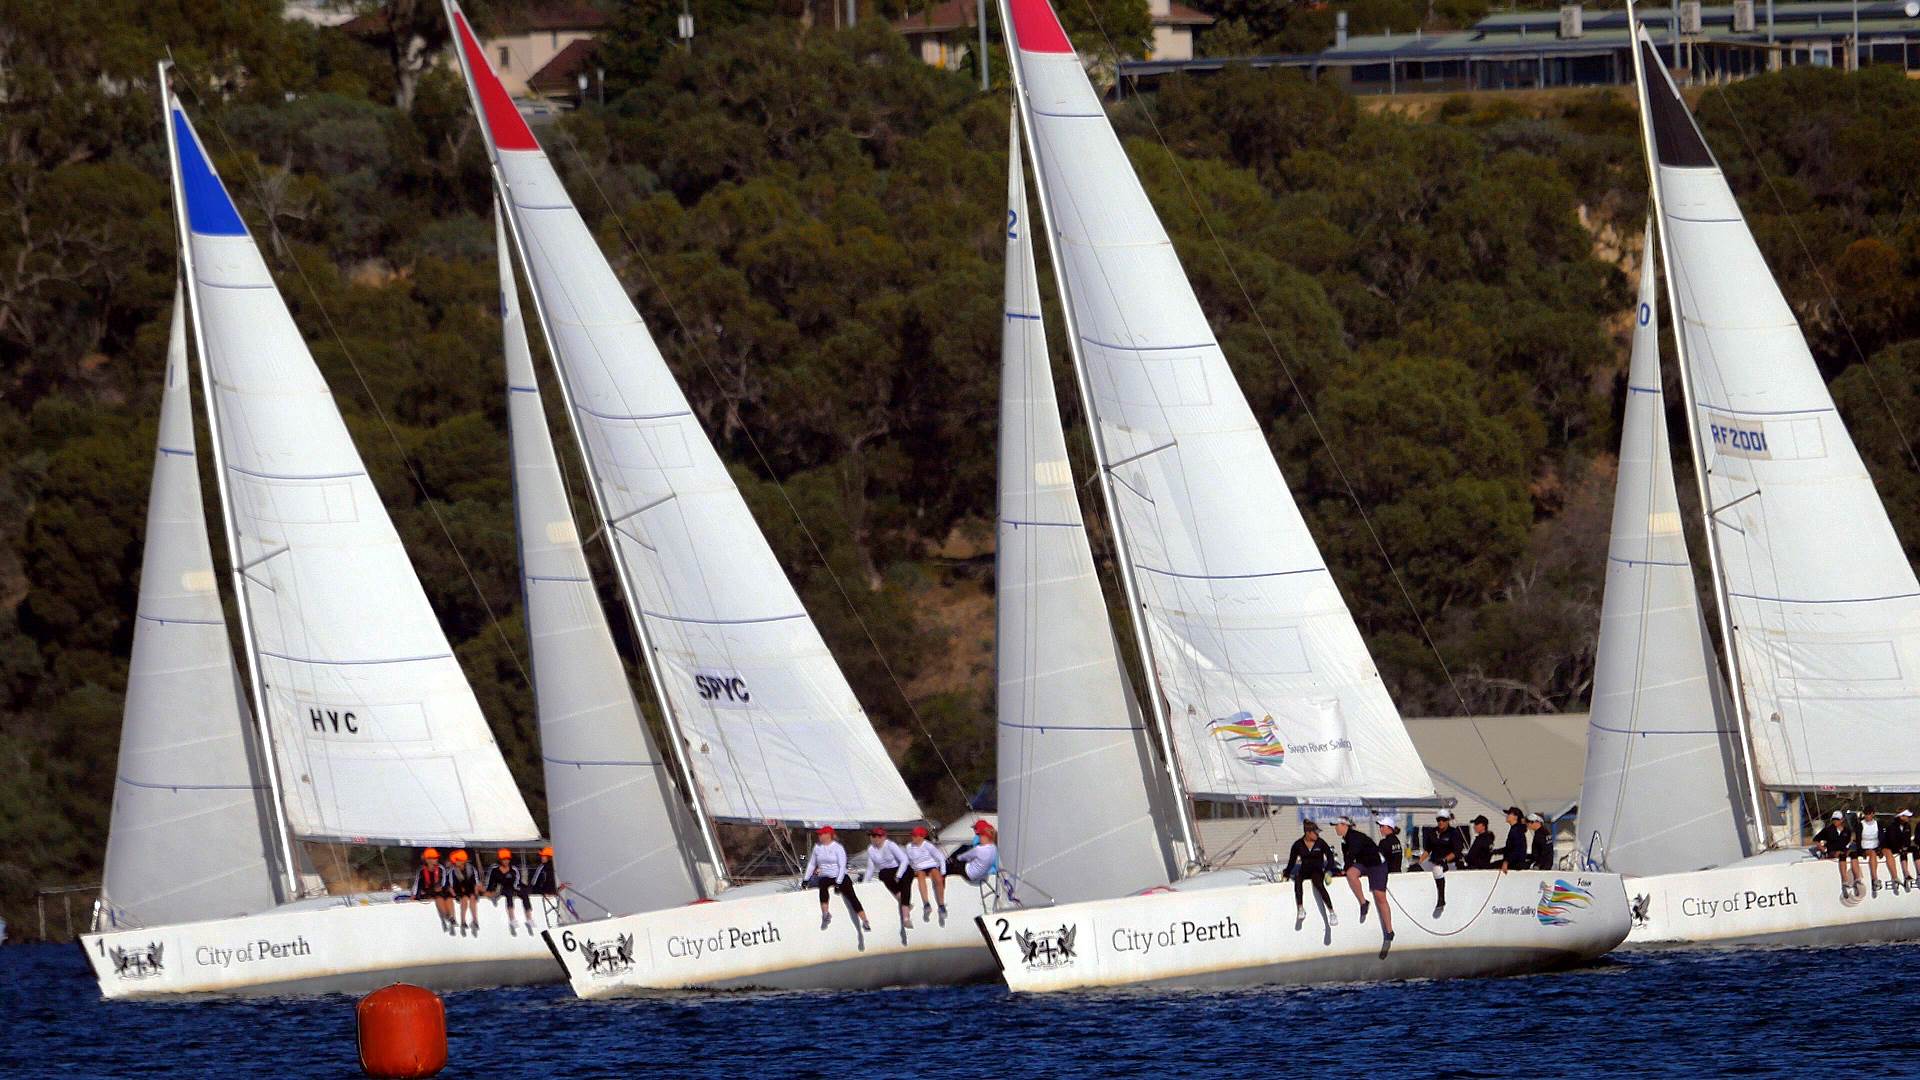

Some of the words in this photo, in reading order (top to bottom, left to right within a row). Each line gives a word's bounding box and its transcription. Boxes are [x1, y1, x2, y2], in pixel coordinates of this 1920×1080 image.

[1007, 209, 1018, 240] 2
[695, 675, 750, 703] SPYC
[309, 707, 359, 735] HYC
[1287, 743, 1309, 754] Swan
[1309, 742, 1328, 753] River
[1329, 737, 1353, 752] Sailing
[1491, 905, 1506, 915] Swan
[1507, 905, 1520, 915] River
[1520, 905, 1536, 918] Sailing
[1682, 897, 1719, 918] City
[1722, 892, 1740, 913] of
[1743, 886, 1799, 910] Perth
[562, 930, 578, 952] 6
[667, 935, 703, 959] City
[707, 929, 725, 952] of
[728, 921, 782, 950] Perth
[995, 918, 1012, 942] 2
[1111, 928, 1154, 955] City
[1157, 922, 1177, 947] of
[1181, 915, 1242, 944] Perth
[95, 936, 105, 957] 1
[195, 945, 232, 968] City
[236, 941, 253, 963] of
[257, 935, 311, 960] Perth
